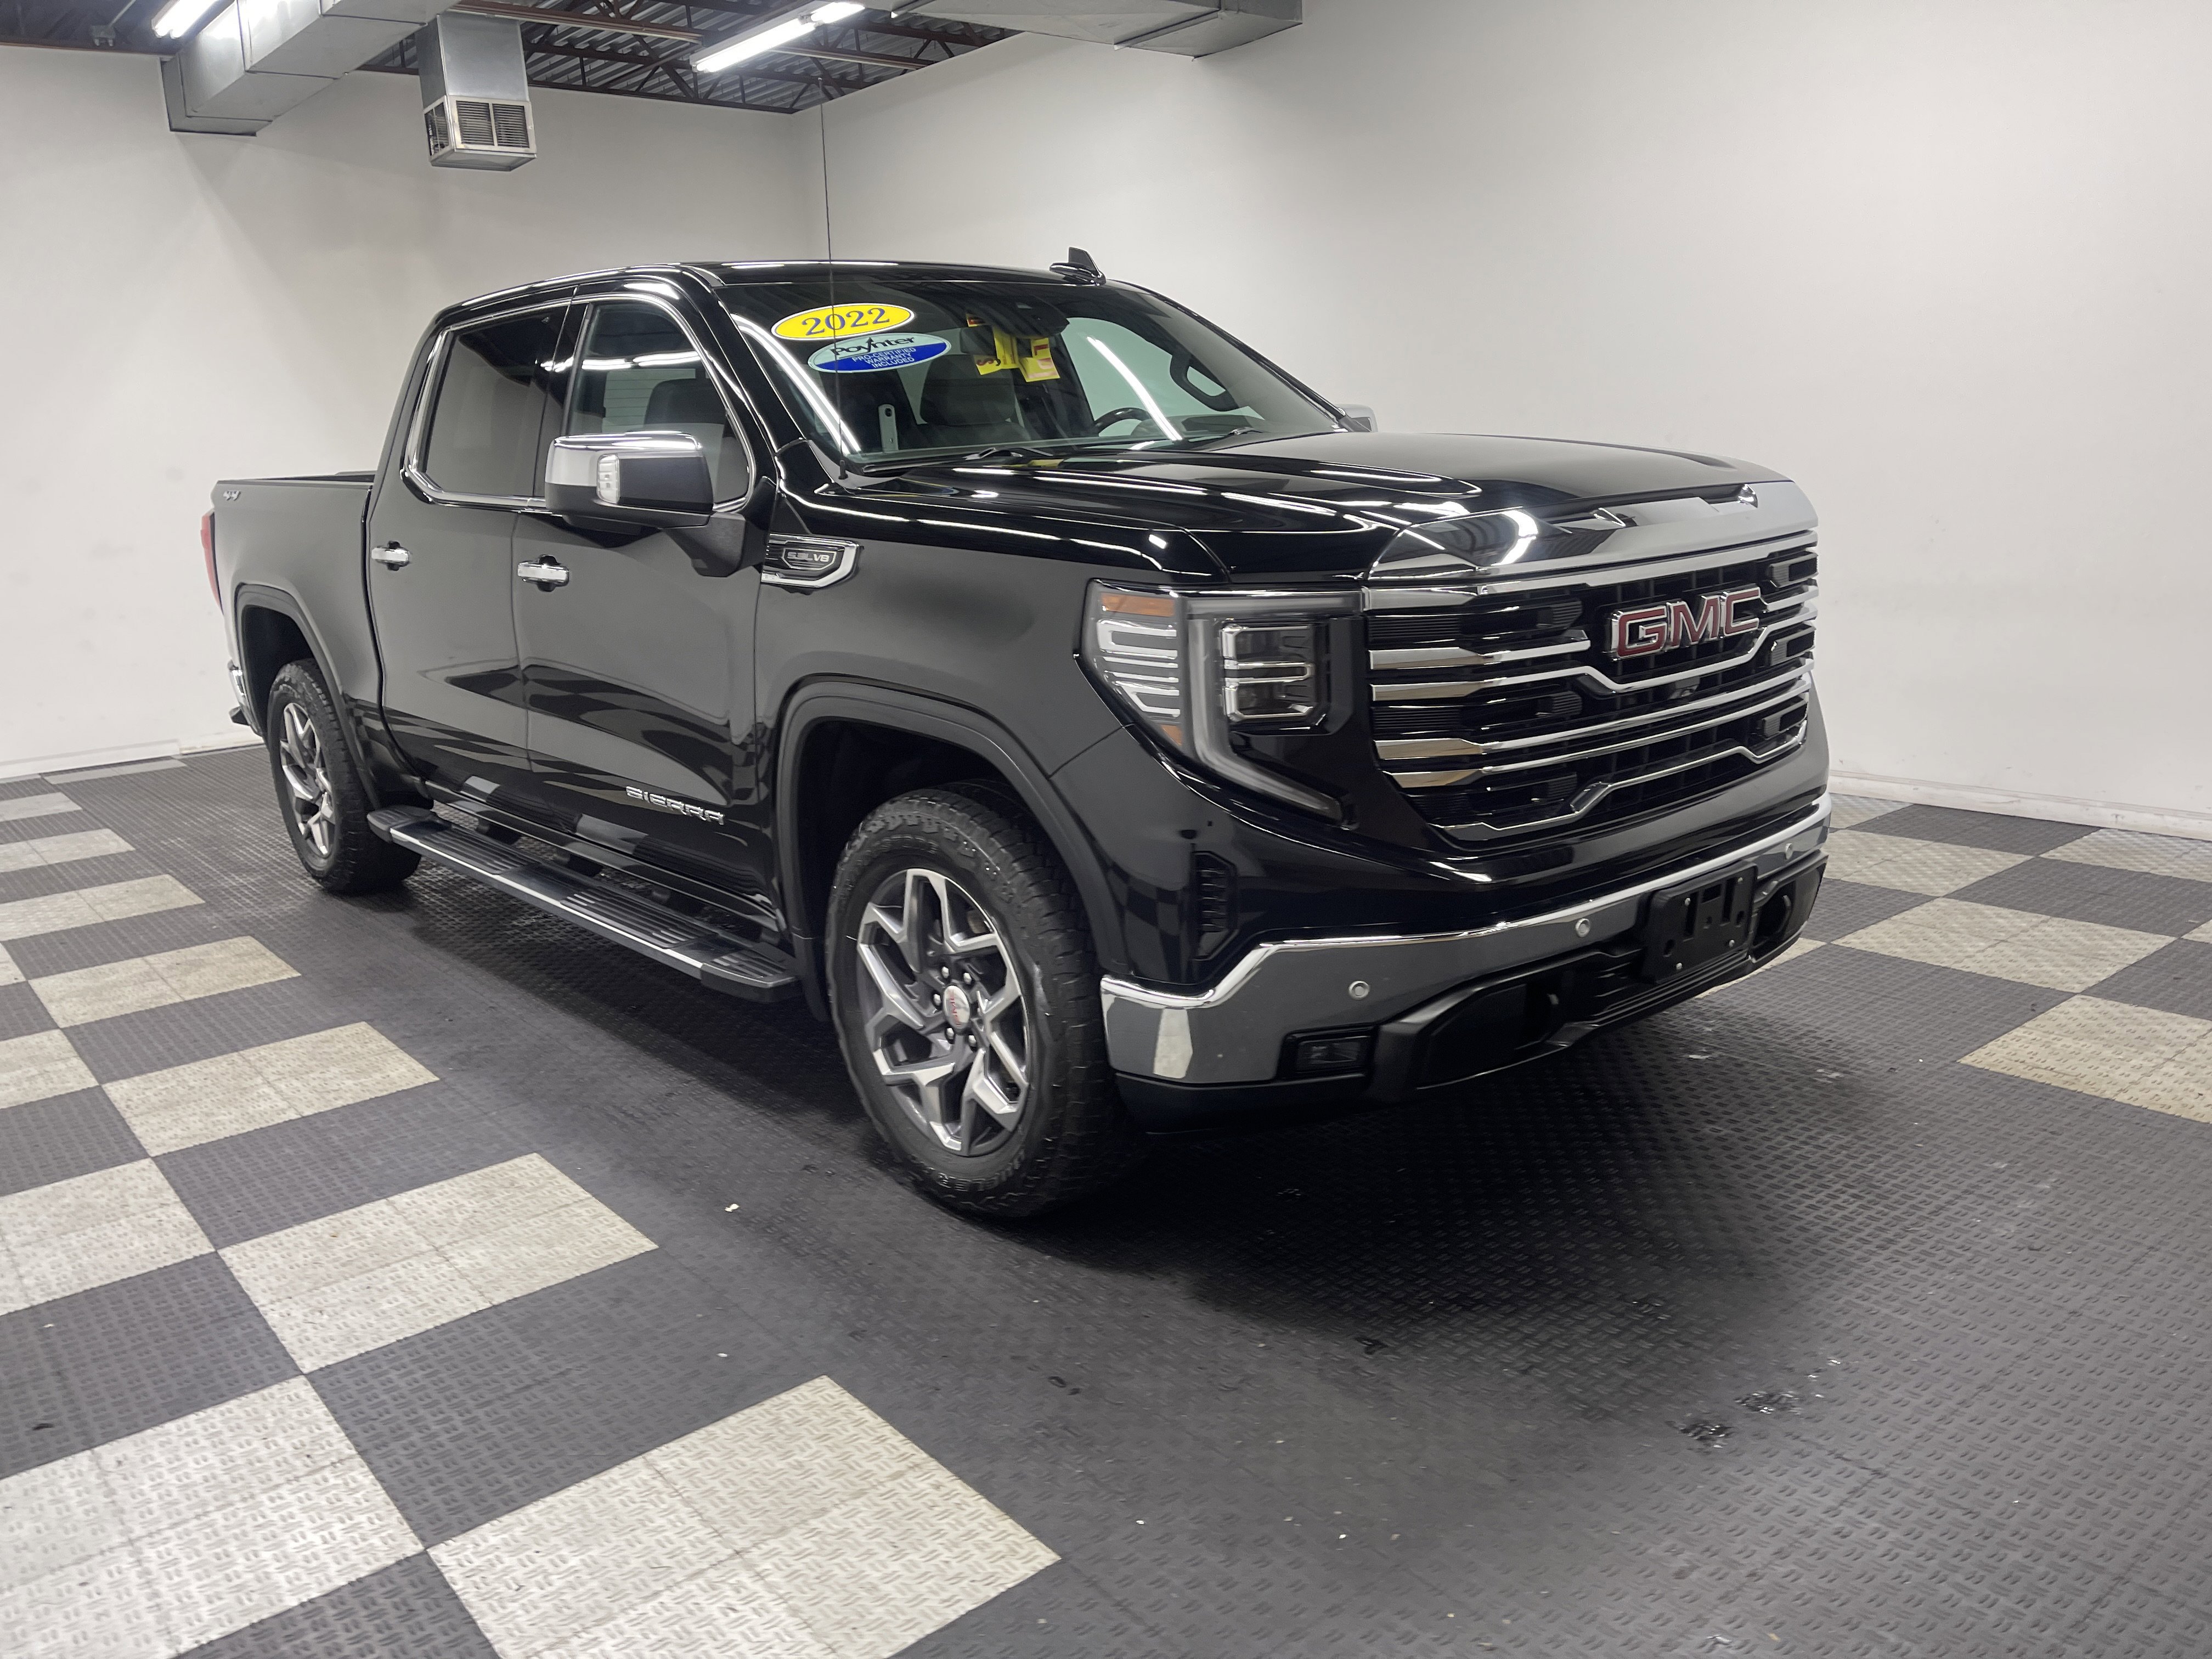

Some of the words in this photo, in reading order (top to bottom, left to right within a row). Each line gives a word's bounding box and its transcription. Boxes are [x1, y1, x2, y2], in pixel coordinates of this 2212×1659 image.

[801, 308, 890, 336] 2022
[830, 337, 915, 356] Poynter
[851, 347, 917, 362] PRO-CERTIFIED
[864, 352, 912, 364] WARRANTY
[871, 357, 915, 368] INCLUDED
[813, 553, 830, 562] V8
[1612, 586, 1762, 659] GMC
[625, 786, 725, 825] SIERRA
